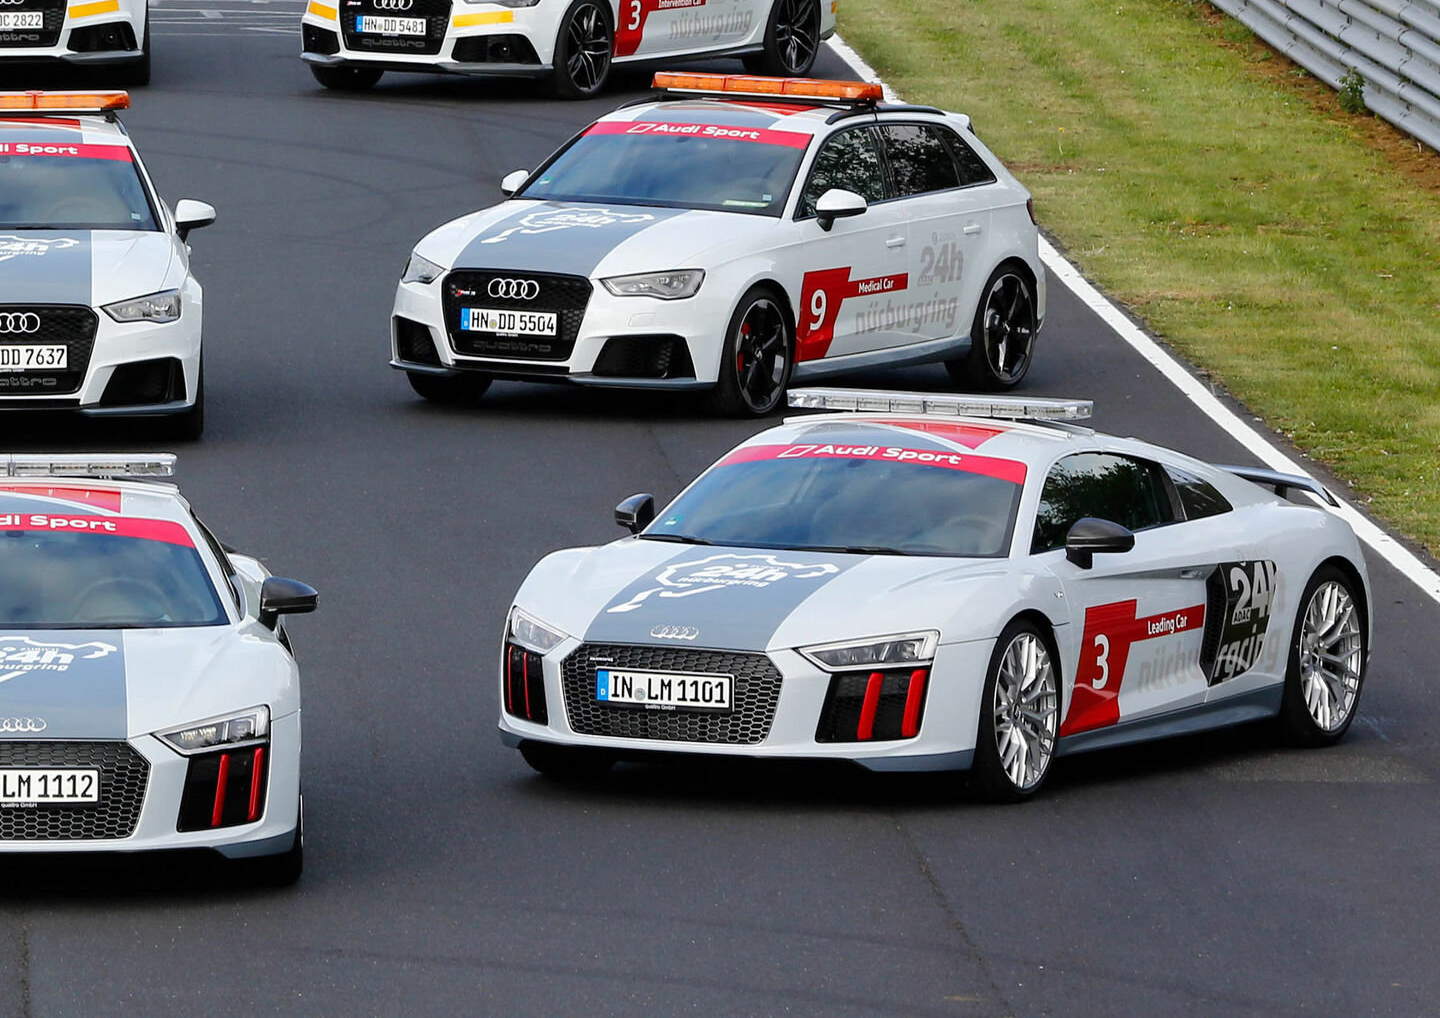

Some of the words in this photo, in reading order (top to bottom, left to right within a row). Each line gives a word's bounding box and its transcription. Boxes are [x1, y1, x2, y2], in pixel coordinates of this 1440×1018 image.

[13, 14, 41, 27] 2822
[627, 0, 642, 30] 3
[364, 18, 377, 31] HN
[384, 19, 397, 32] DD
[398, 19, 424, 33] 5481
[361, 38, 426, 48] quattro
[654, 124, 701, 134] Audi
[702, 126, 760, 139] Sport
[15, 144, 78, 155] Sport
[917, 242, 964, 286] 24h
[858, 278, 883, 294] Medical
[883, 278, 894, 290] Car
[810, 289, 827, 331] 9
[855, 291, 958, 335] nürburgring
[472, 311, 489, 329] HN
[498, 313, 515, 330] DD
[519, 314, 555, 332] 5504
[473, 339, 552, 353] quattro
[1, 349, 20, 365] DD
[25, 348, 65, 365] 7637
[814, 445, 878, 456] Audi
[880, 447, 961, 465] Sport
[29, 515, 117, 532] Sport
[688, 565, 788, 581] 24h
[1147, 617, 1175, 636] Leading
[1175, 614, 1188, 629] Car
[1092, 634, 1110, 690] 3
[612, 675, 633, 699] IN
[647, 677, 672, 702] LM
[677, 680, 726, 704] 1101
[3, 774, 31, 798] LM
[37, 774, 93, 798] 1112
